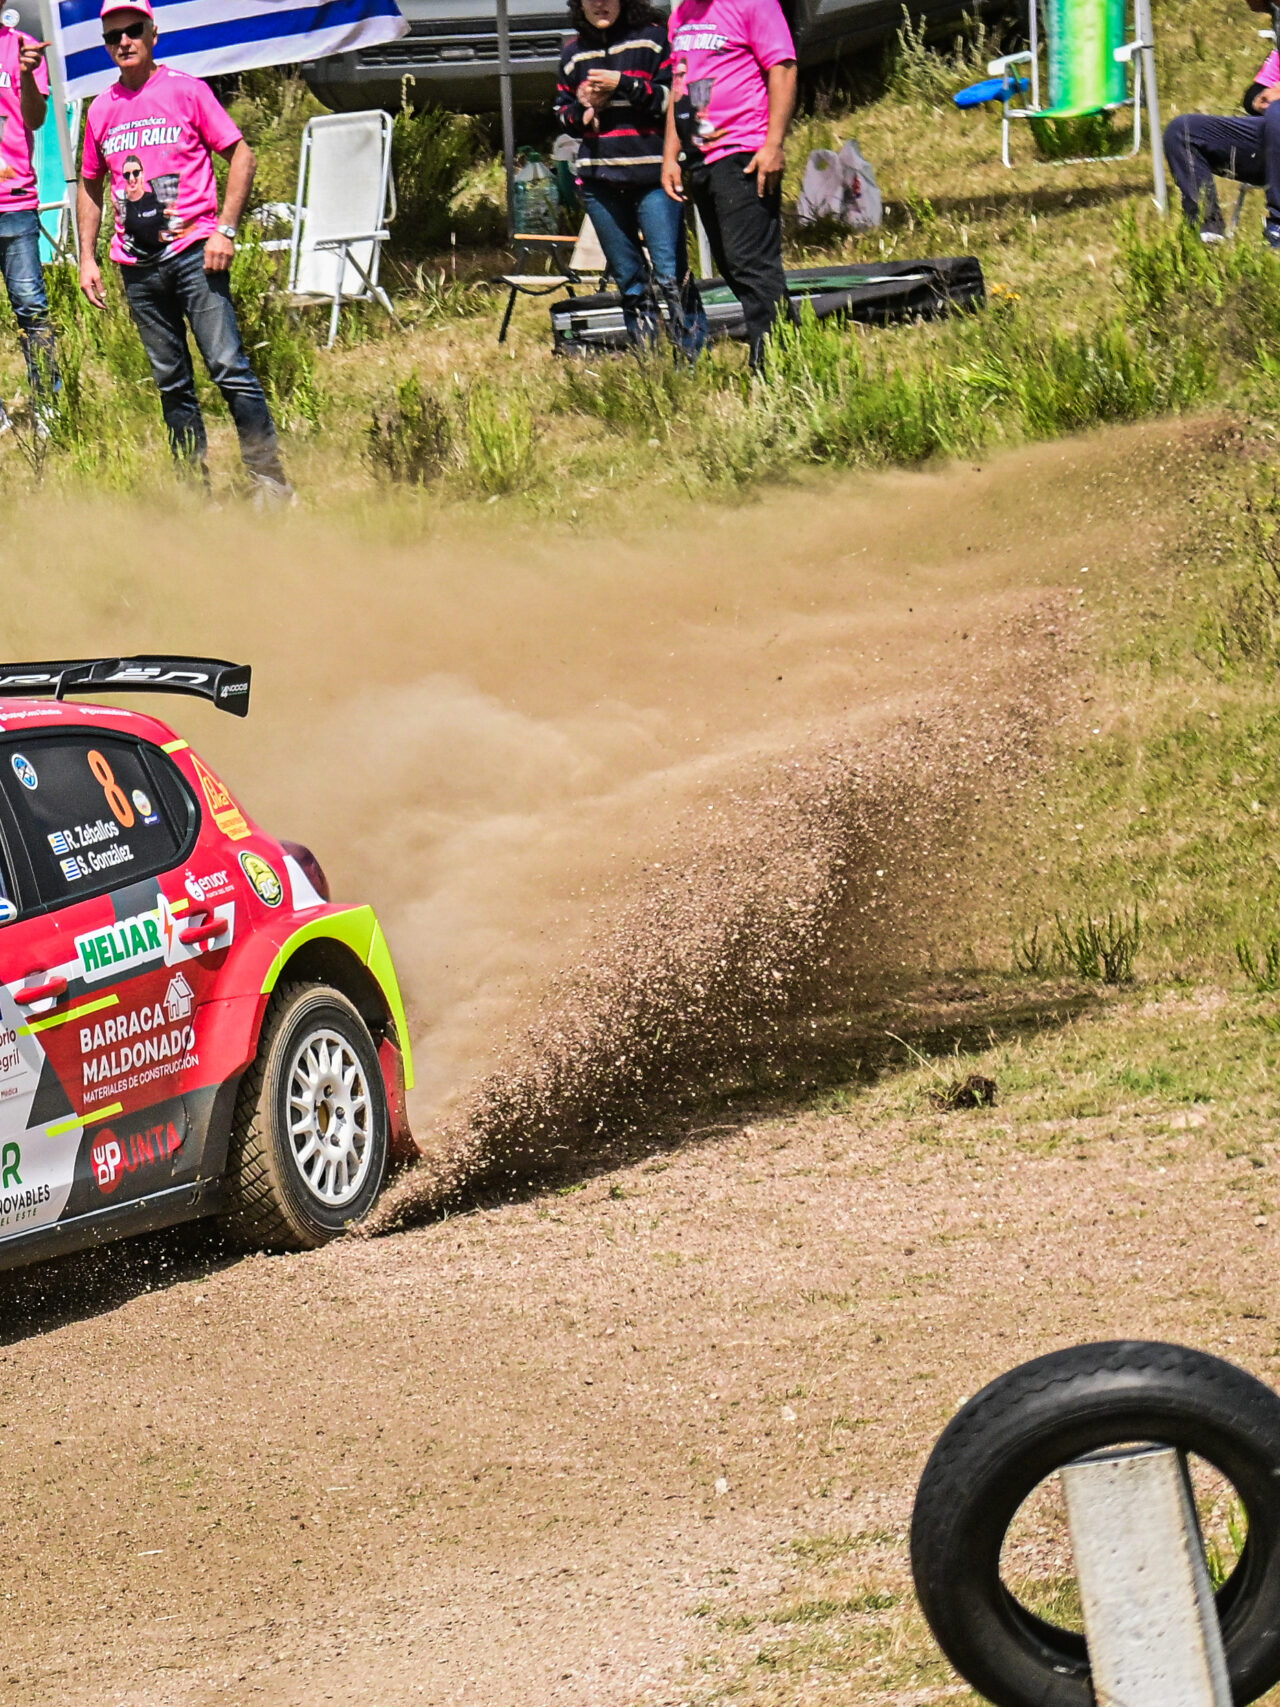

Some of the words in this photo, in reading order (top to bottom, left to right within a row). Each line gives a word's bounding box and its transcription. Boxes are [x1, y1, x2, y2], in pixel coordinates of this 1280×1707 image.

[140, 126, 182, 148] RALLY
[87, 750, 136, 829] 8
[62, 829, 81, 851] R.
[74, 819, 120, 848] Zeballos
[76, 855, 93, 876] S.
[87, 843, 135, 872] González
[79, 917, 162, 973] HELIAR
[80, 1003, 166, 1054] BARRACA
[83, 1025, 196, 1086] MALDONADO
[83, 1079, 127, 1104] MATERIALES
[128, 1073, 139, 1087] DE
[139, 1054, 200, 1084] CONSTRUCCIÓN
[16, 1208, 37, 1222] ESTE
